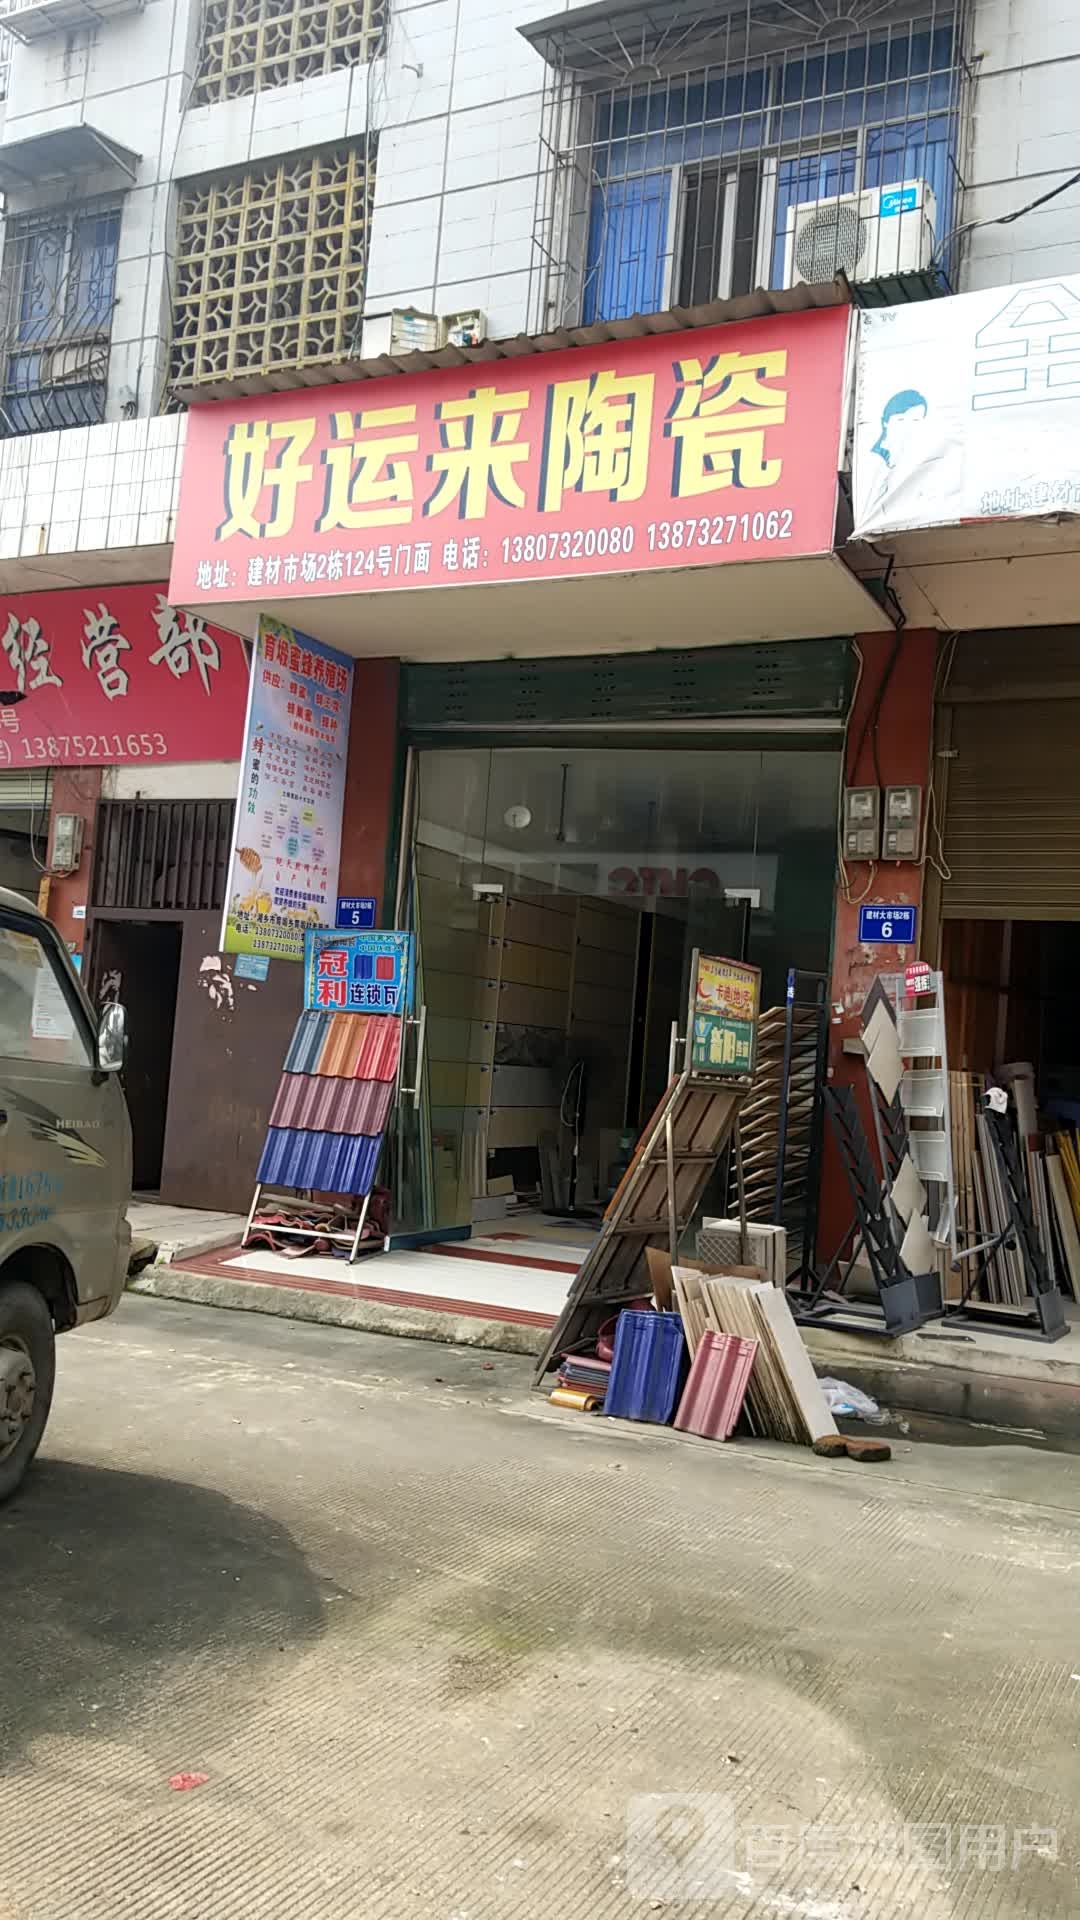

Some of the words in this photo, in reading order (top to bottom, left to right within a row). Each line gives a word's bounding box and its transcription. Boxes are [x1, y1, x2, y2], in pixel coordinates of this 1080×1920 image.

[216, 349, 788, 541] 好运来陶瓷
[647, 509, 793, 552] 13873271062
[1, 593, 221, 701] 经营部
[22, 733, 168, 760] 13875211653
[351, 911, 360, 925] 5
[865, 910, 910, 920] 建材大市场2栋
[881, 921, 893, 938] 6
[350, 983, 399, 1006] 连锁瓦
